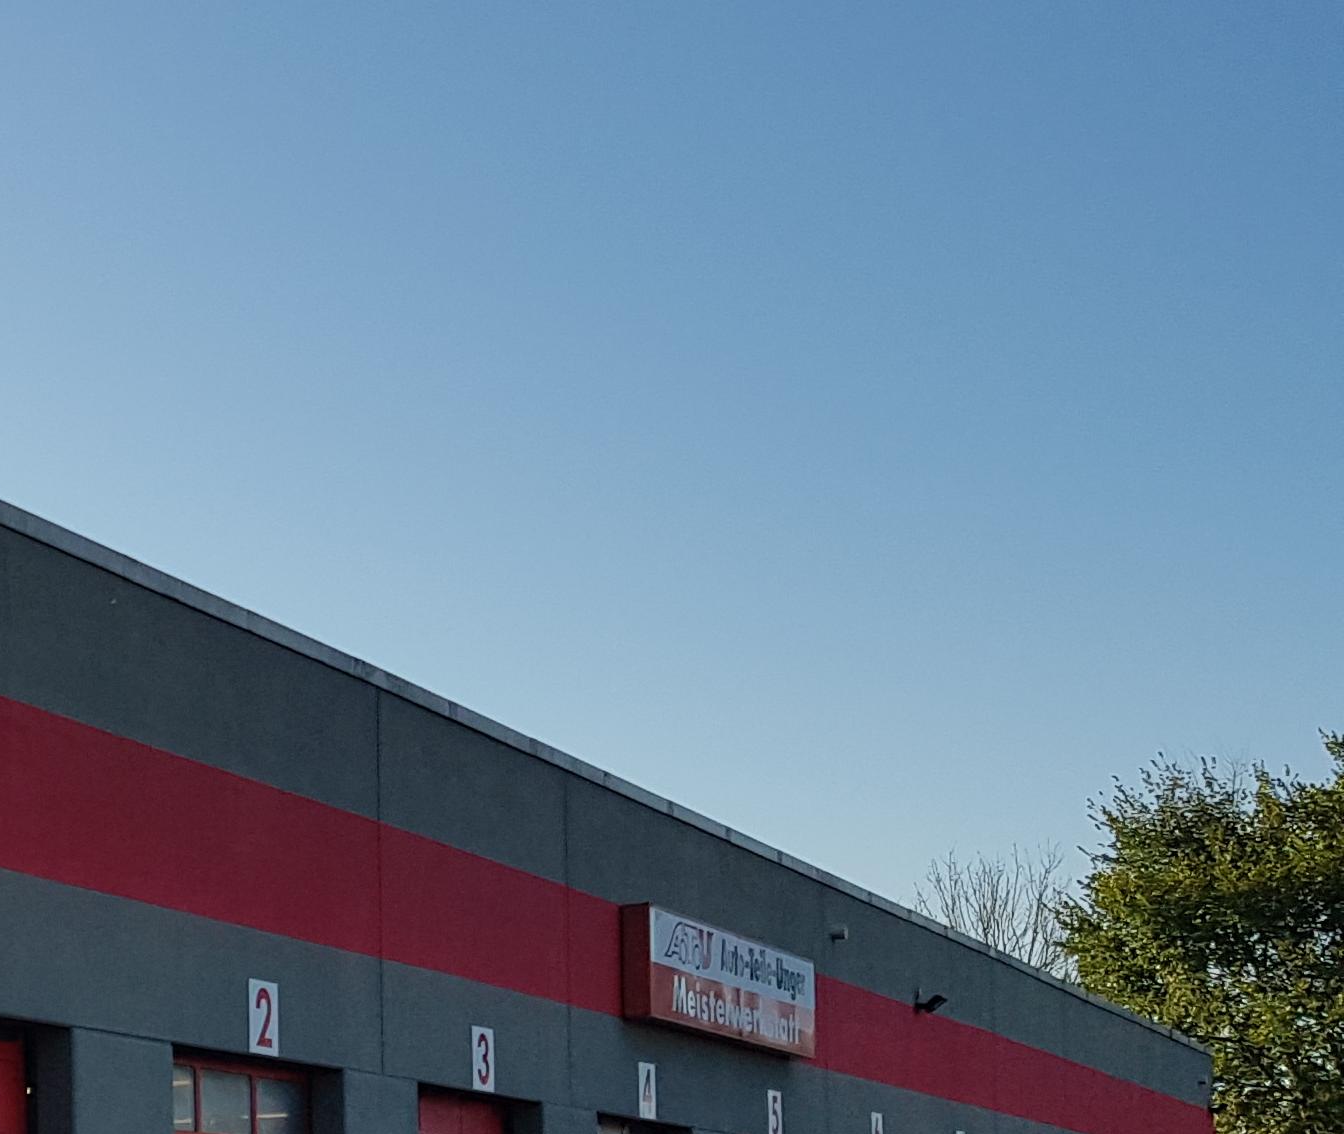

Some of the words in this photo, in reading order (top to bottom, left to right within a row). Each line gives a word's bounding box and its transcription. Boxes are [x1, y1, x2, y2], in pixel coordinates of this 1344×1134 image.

[720, 938, 806, 1001] Auto-Teile-Unger
[255, 987, 272, 1048] 2
[477, 1032, 490, 1086] 3
[643, 1069, 653, 1112] 4
